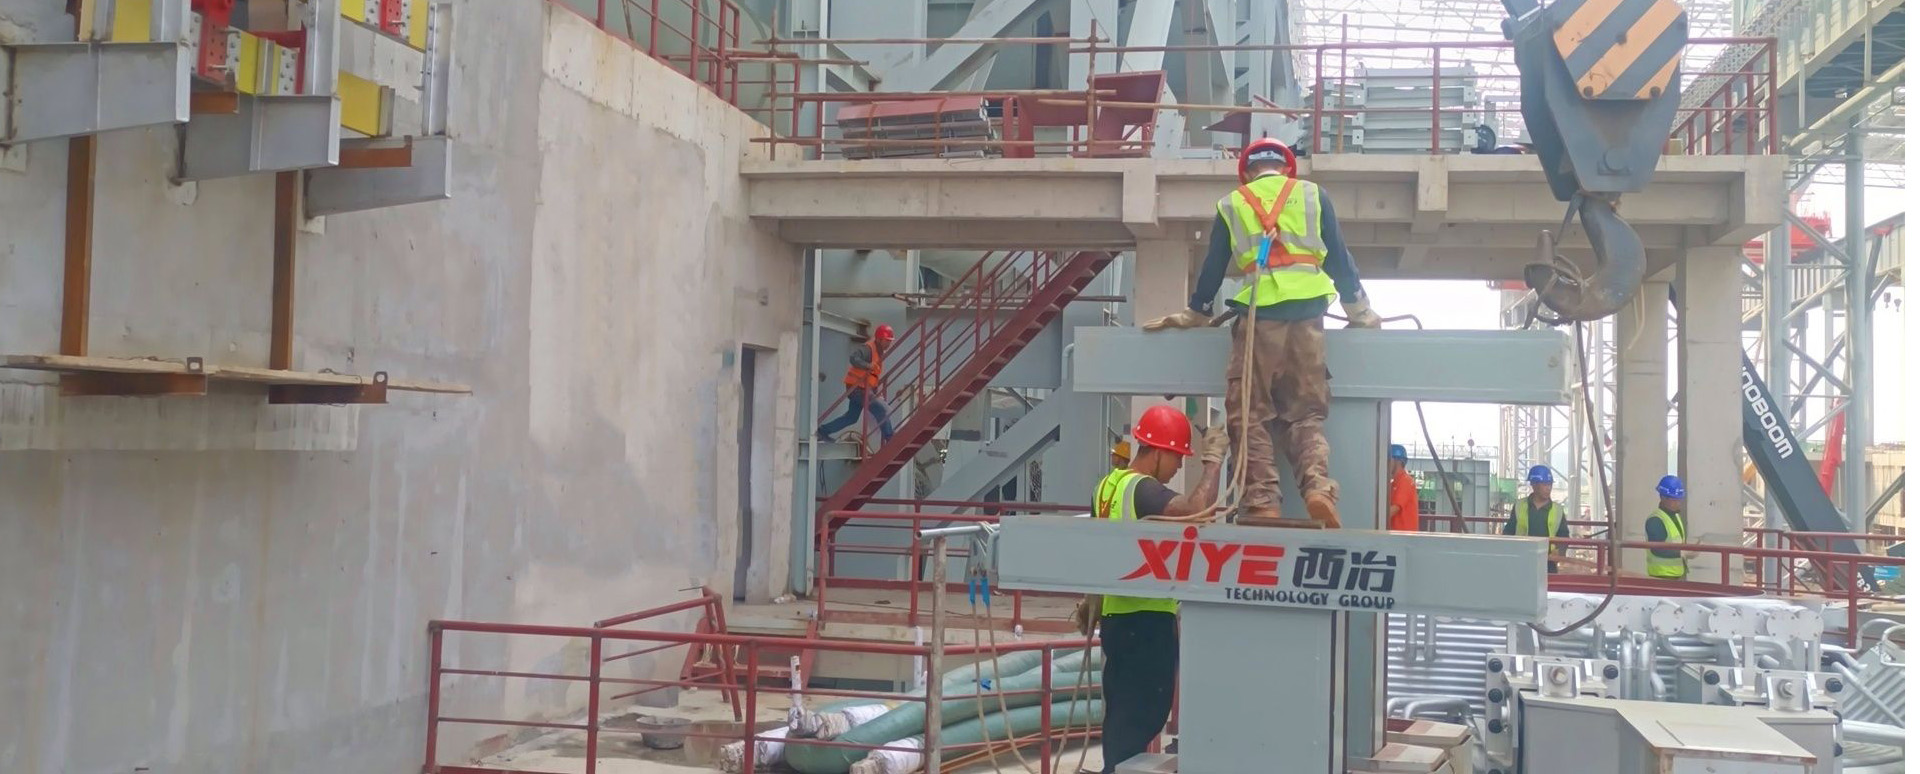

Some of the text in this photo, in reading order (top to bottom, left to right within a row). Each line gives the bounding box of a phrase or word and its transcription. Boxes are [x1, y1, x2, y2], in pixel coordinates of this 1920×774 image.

[1292, 547, 1397, 593] 西冶
[1225, 587, 1395, 609] TECHNOLOGY GROUP
